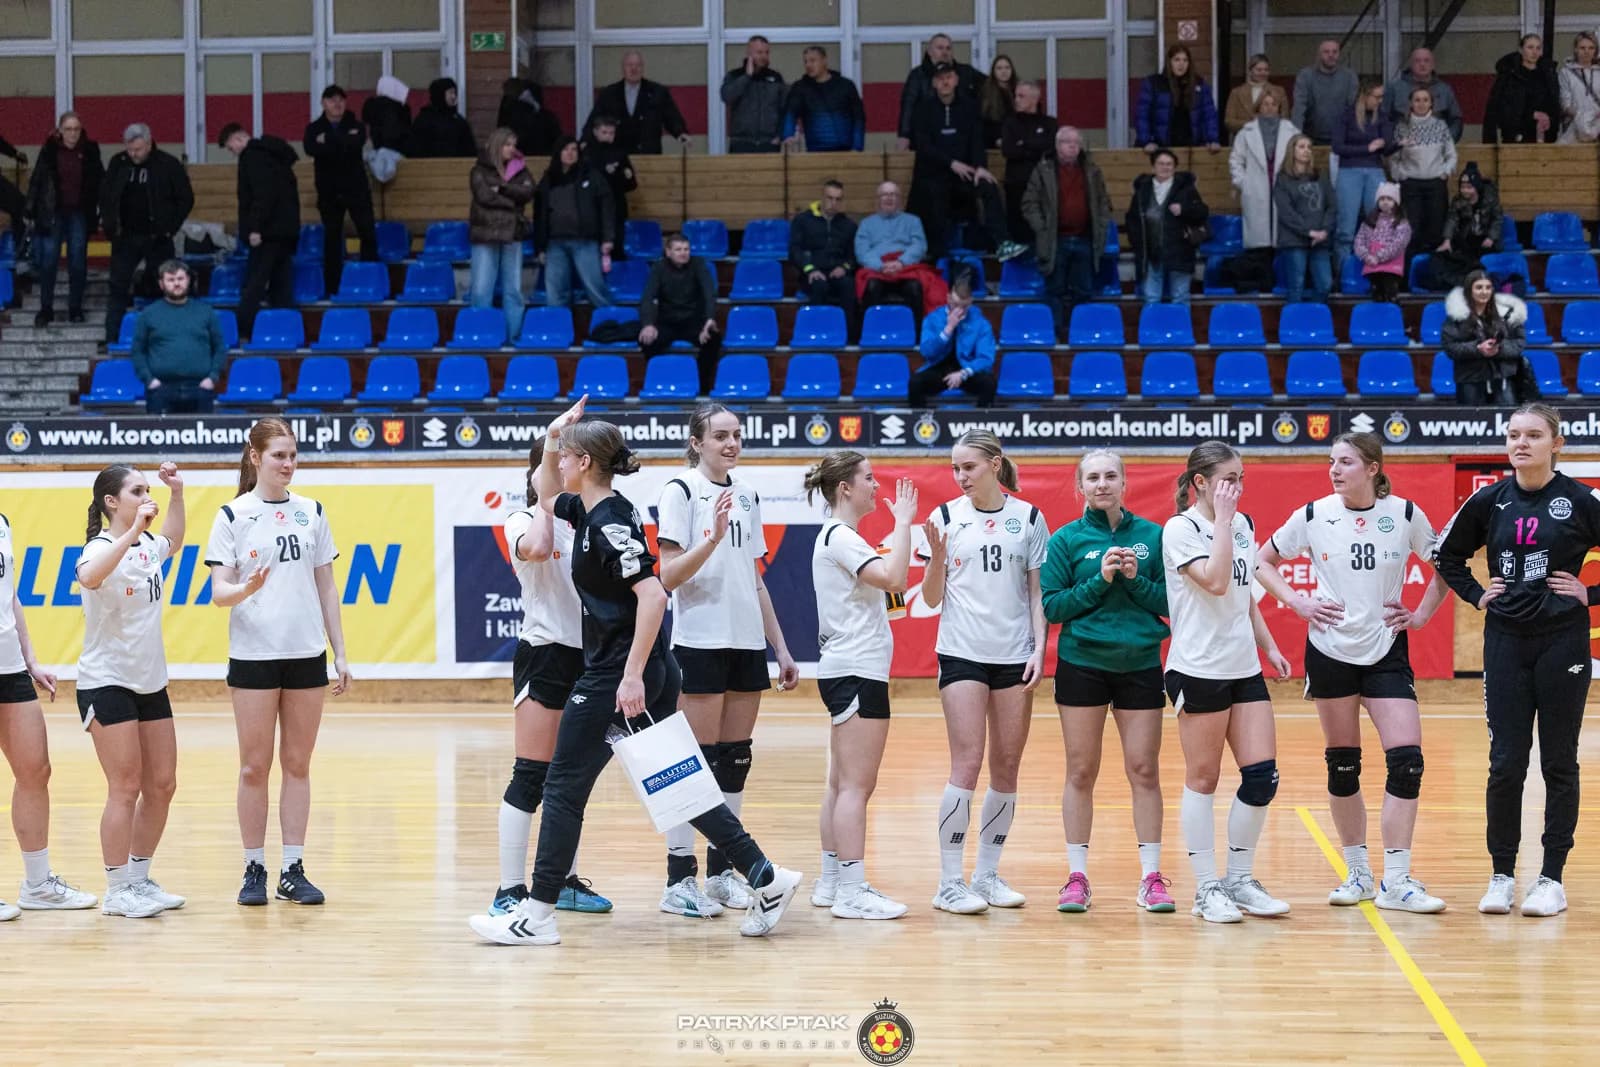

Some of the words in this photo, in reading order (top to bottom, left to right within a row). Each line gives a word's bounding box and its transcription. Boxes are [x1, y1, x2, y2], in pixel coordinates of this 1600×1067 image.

[728, 519, 742, 548] 11
[1514, 516, 1539, 545] 12
[276, 534, 301, 562] 26
[979, 544, 1002, 573] 13
[1350, 542, 1376, 570] 38
[1232, 557, 1249, 586] 42
